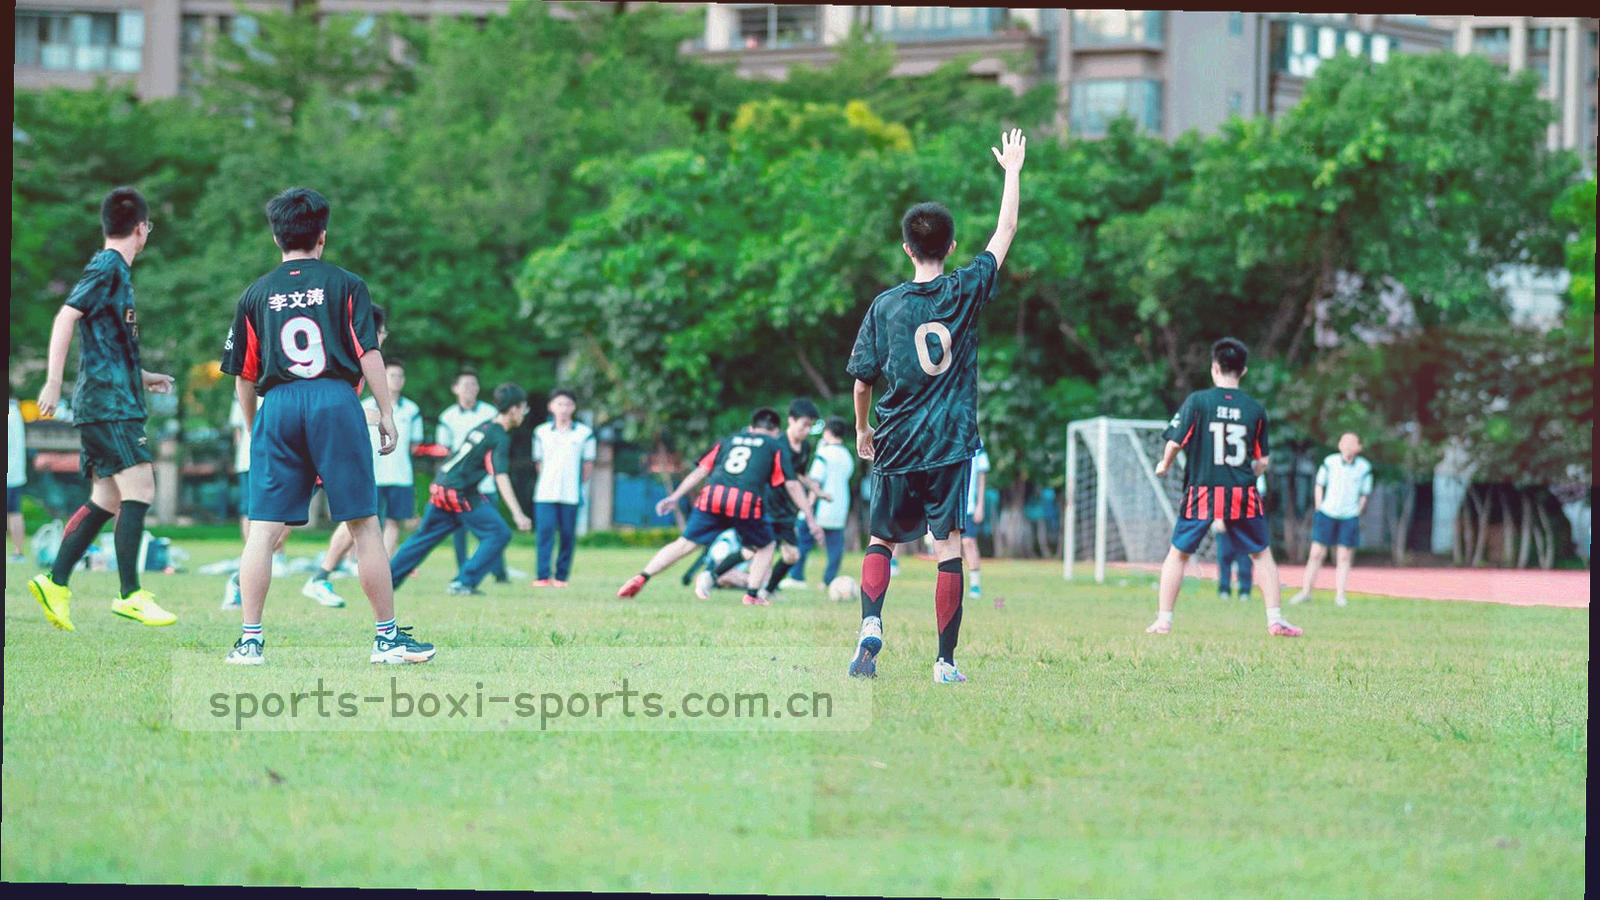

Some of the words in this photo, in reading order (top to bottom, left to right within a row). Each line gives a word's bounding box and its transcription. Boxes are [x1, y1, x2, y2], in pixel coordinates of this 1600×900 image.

[268, 287, 324, 312] 李文涛
[280, 315, 327, 379] 9
[914, 321, 952, 377] 0
[724, 445, 752, 474] 8
[1208, 421, 1247, 467] 13
